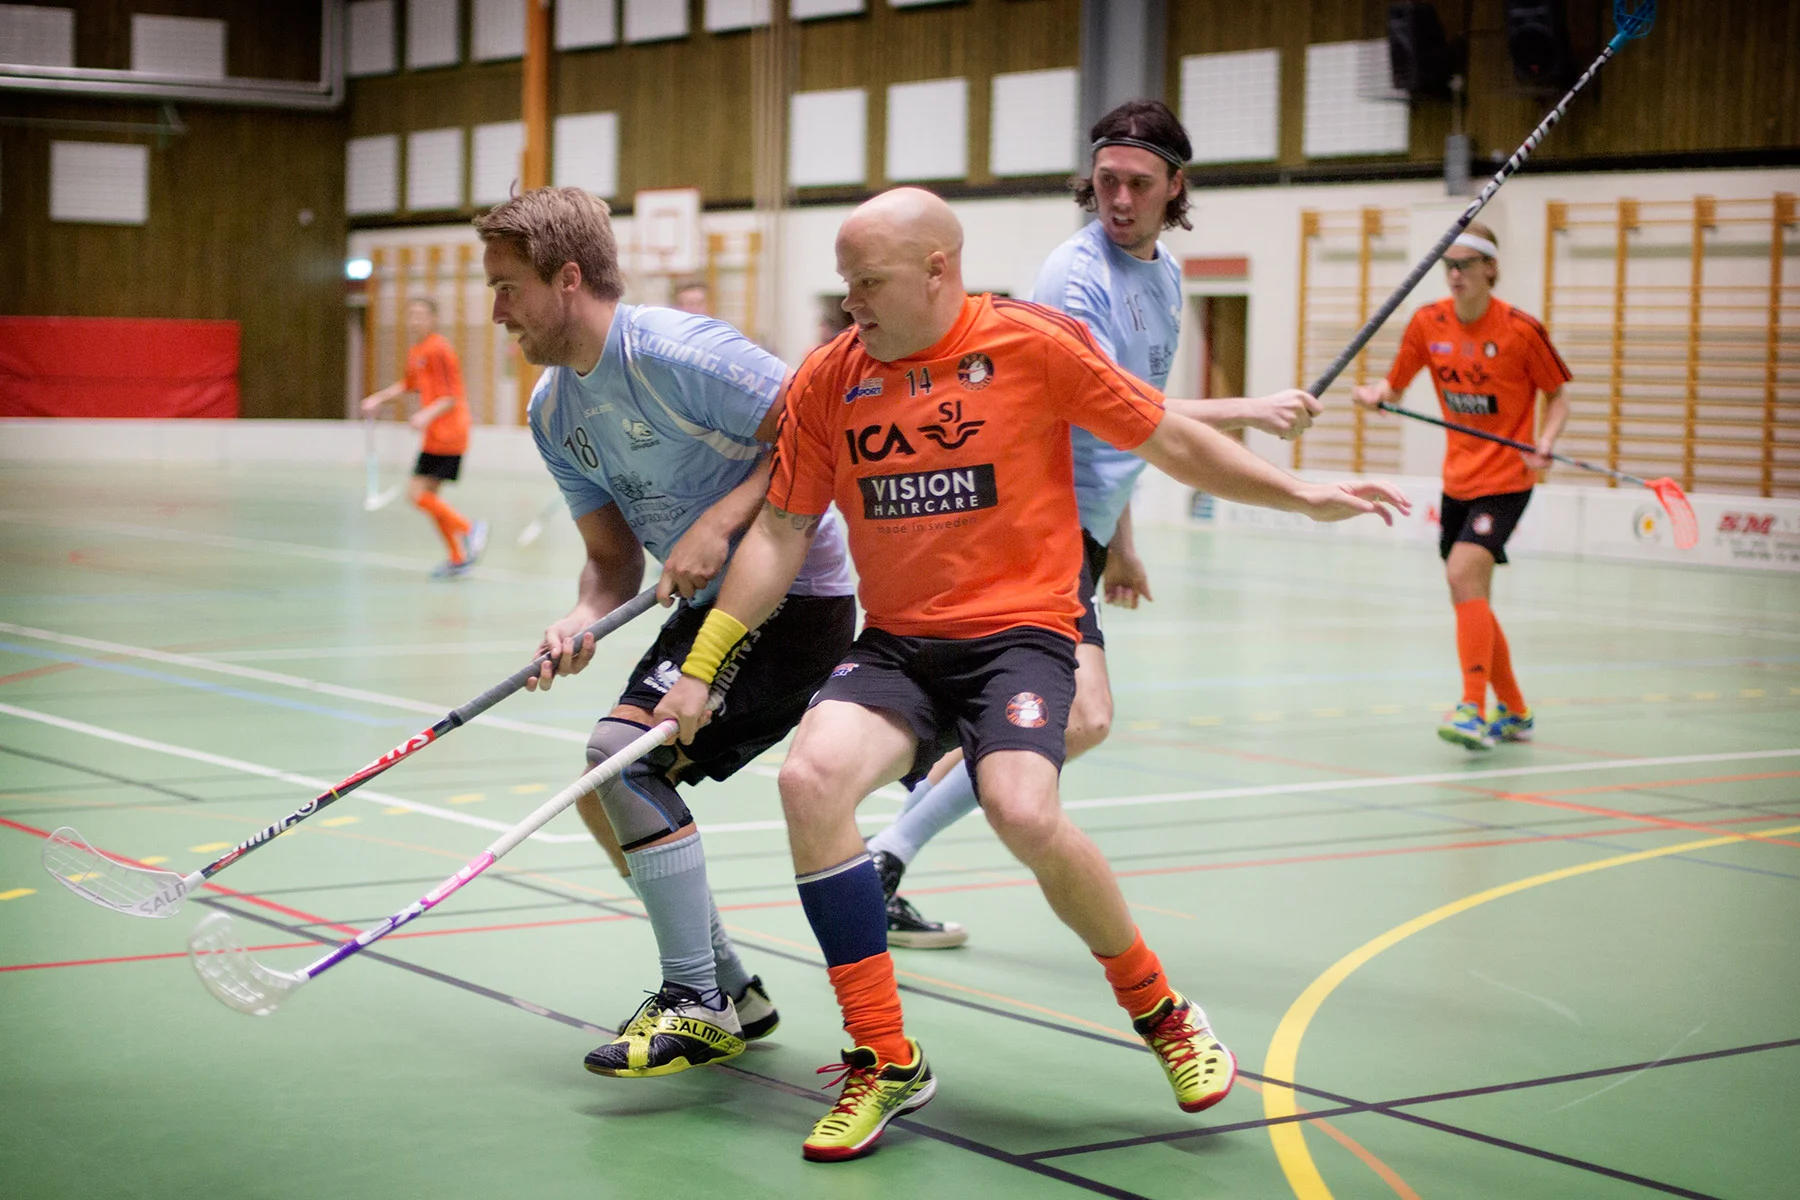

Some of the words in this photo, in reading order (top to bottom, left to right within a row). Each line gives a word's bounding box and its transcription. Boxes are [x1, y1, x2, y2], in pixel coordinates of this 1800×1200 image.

[904, 367, 932, 396] 14
[938, 400, 962, 423] SJ
[564, 426, 599, 472] 18
[845, 422, 916, 465] ICA
[872, 470, 975, 501] VISION
[874, 495, 979, 516] HAIRCARE
[877, 523, 907, 534] made
[912, 522, 924, 532] in
[928, 516, 977, 531] sweden
[664, 1018, 728, 1043] SALMI
